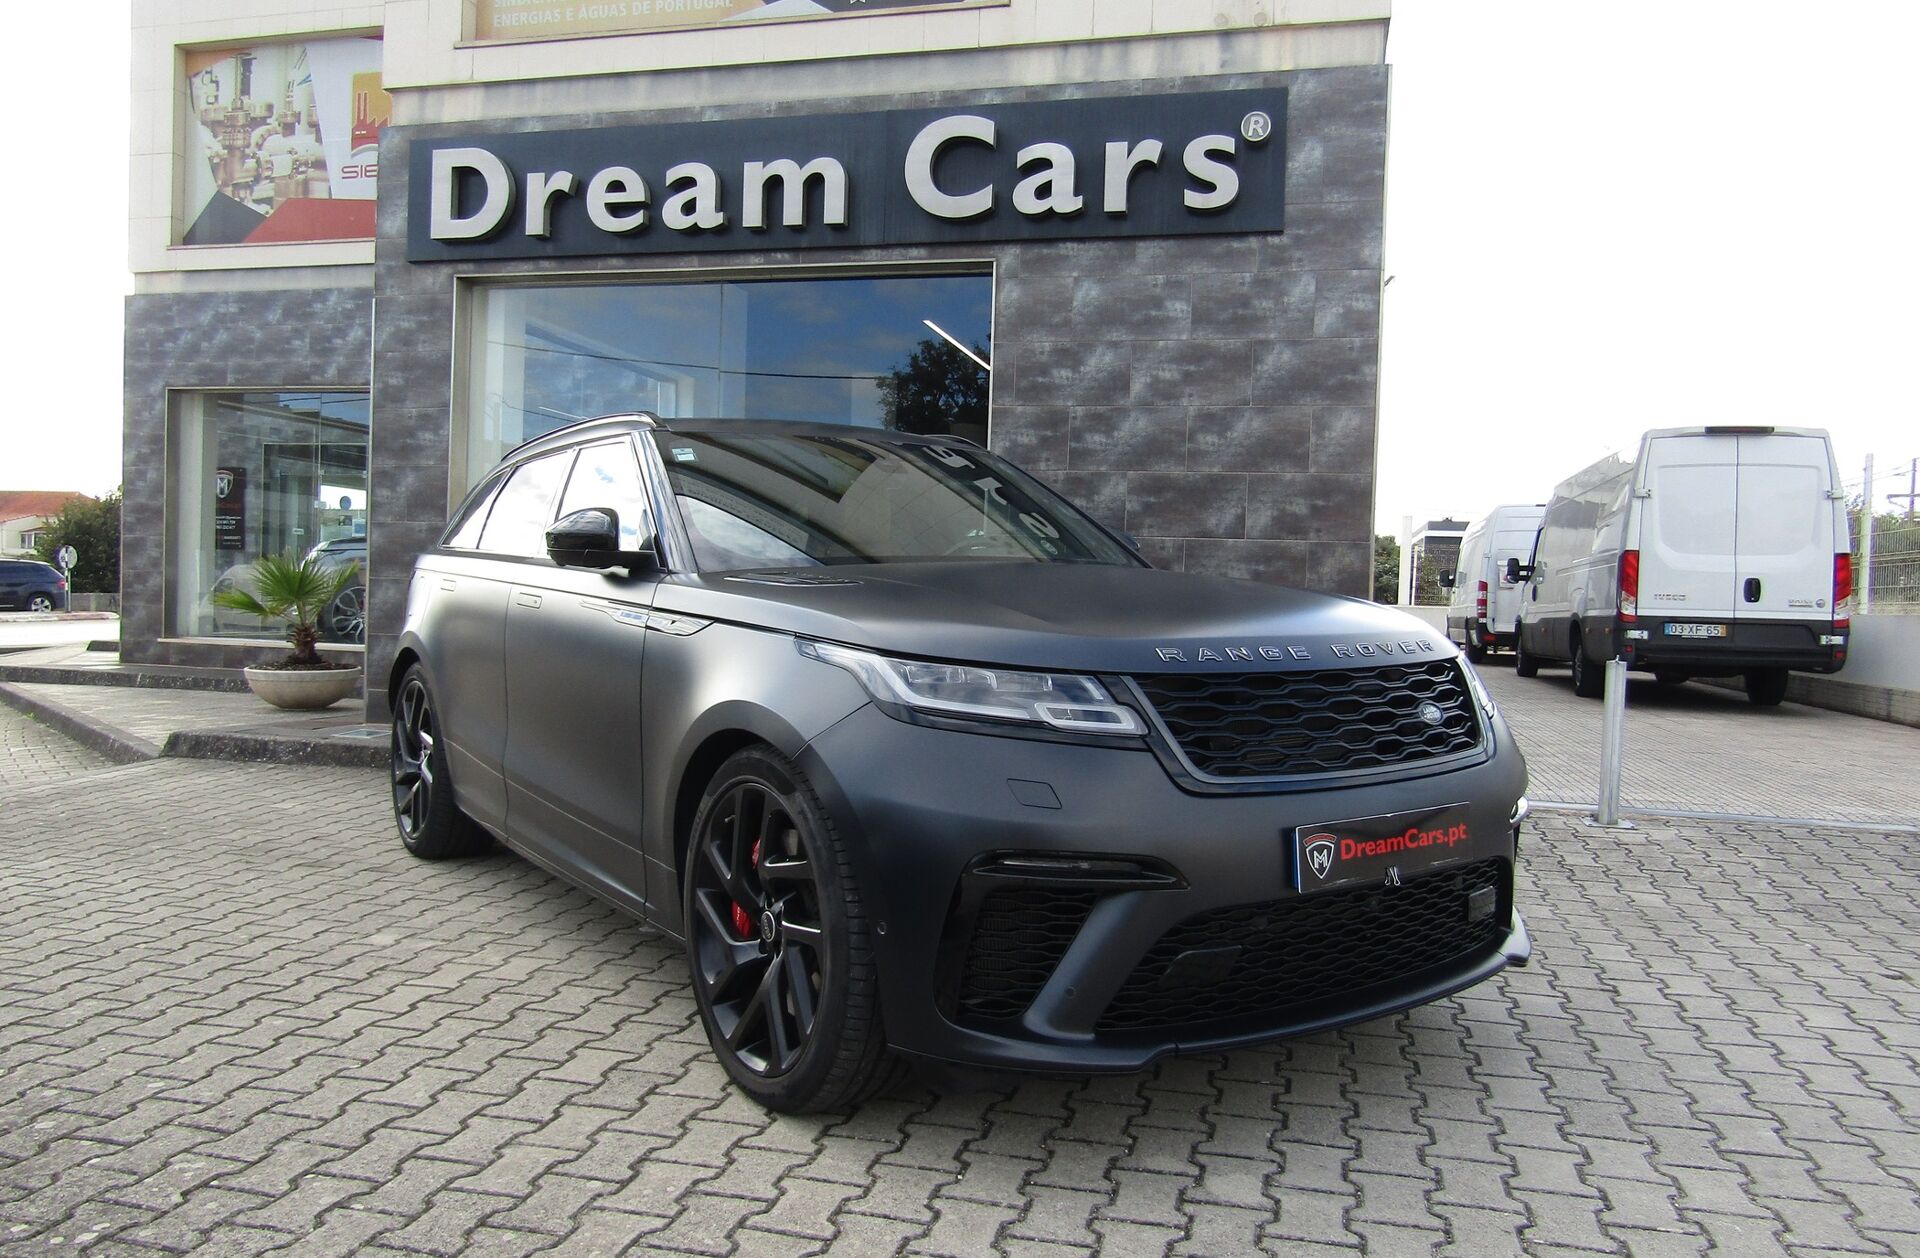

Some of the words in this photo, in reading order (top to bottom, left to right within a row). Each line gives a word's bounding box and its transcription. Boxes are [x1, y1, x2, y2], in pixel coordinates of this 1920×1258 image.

[493, 9, 561, 27] ENERGIAS
[565, 8, 574, 20] E
[632, 1, 651, 15] DE
[655, 0, 733, 13] PORTUGAL
[430, 147, 850, 241] Dream
[904, 114, 1240, 219] Cars
[1154, 645, 1312, 662] RANGE
[1330, 638, 1435, 659] ROVER
[1340, 823, 1467, 860] DreamCars.pt
